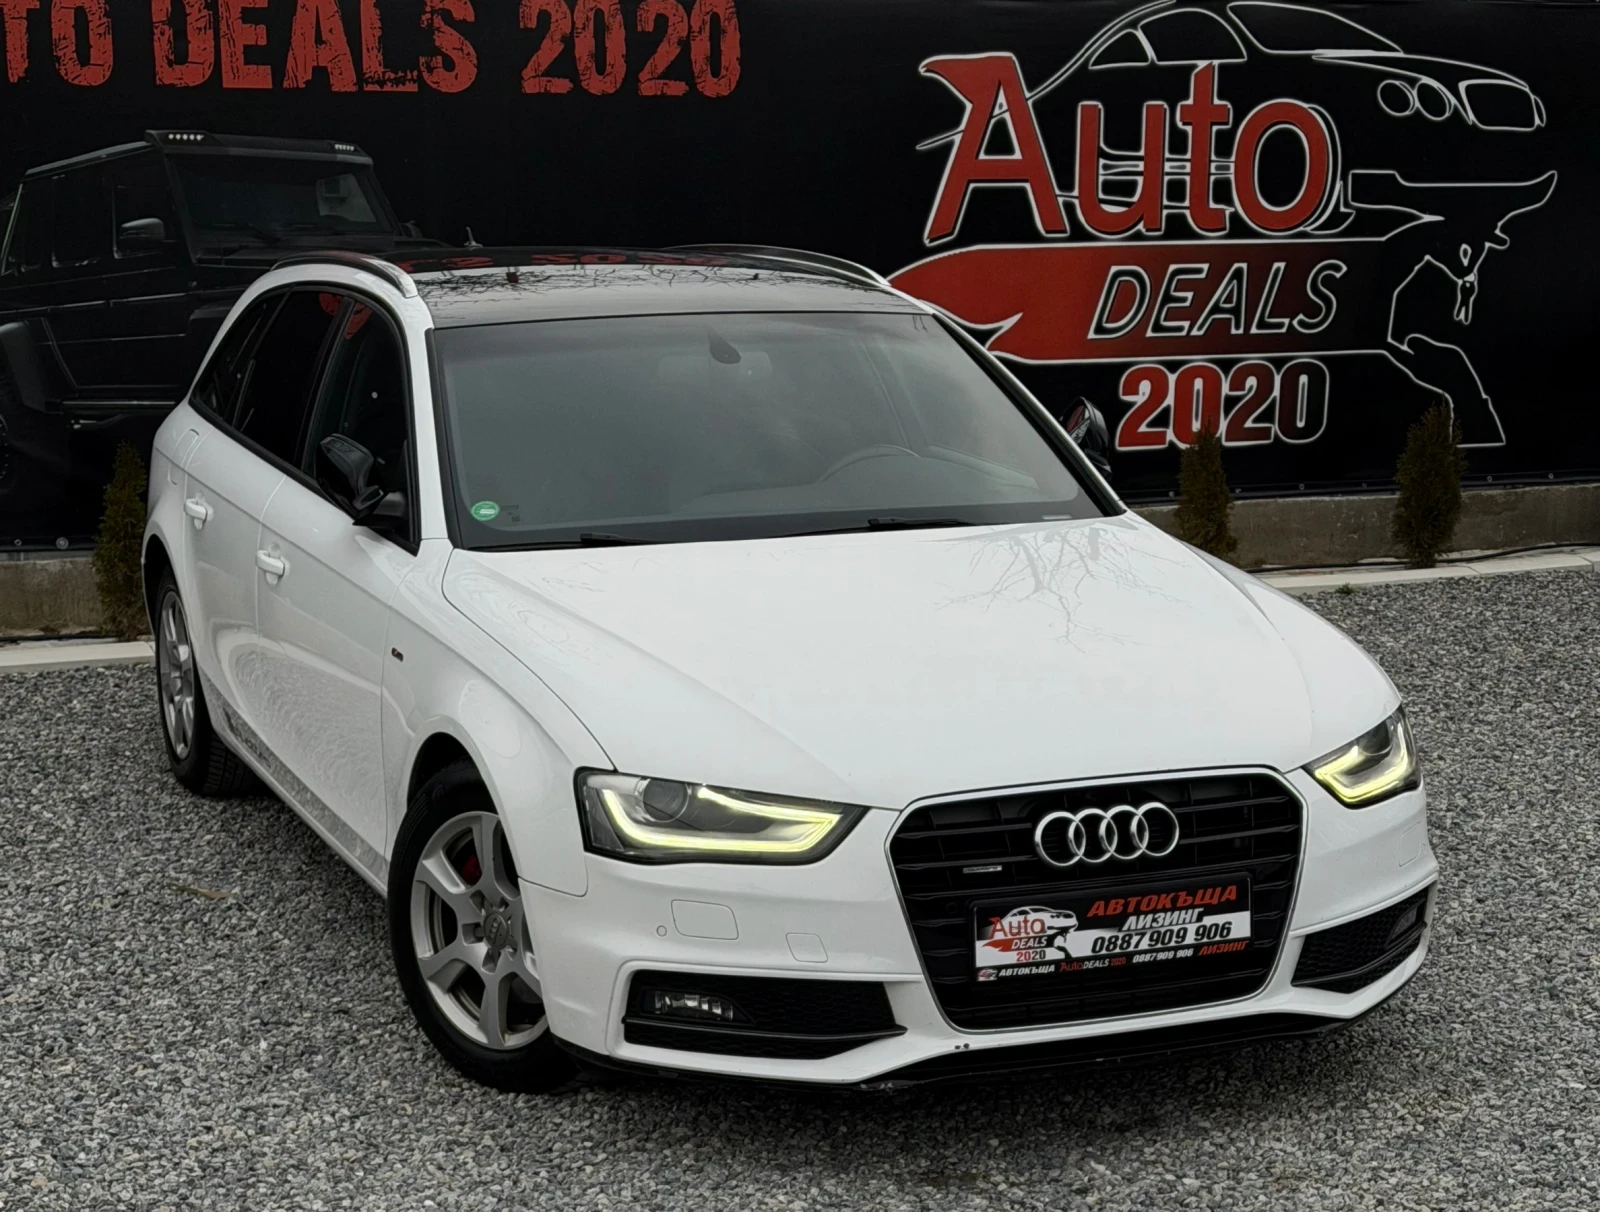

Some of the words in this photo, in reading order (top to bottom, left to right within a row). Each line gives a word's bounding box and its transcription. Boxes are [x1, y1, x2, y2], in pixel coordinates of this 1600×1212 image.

[152, 0, 478, 93] DEALS
[520, 0, 743, 98] 2020
[919, 53, 1334, 245] Auto
[1087, 259, 1347, 339] DEALS
[1116, 358, 1330, 451] 2020
[1086, 885, 1237, 918] АВТОКЪЩА
[988, 914, 1046, 939] Auto
[1122, 907, 1204, 931] ЛИЗИНГ
[1193, 921, 1232, 942] 906
[998, 964, 1056, 977] АВТОКЪЩА
[1198, 940, 1250, 957] ЛИЗИНГ
[1011, 936, 1048, 949] DEALS
[1016, 950, 1046, 962] 2020
